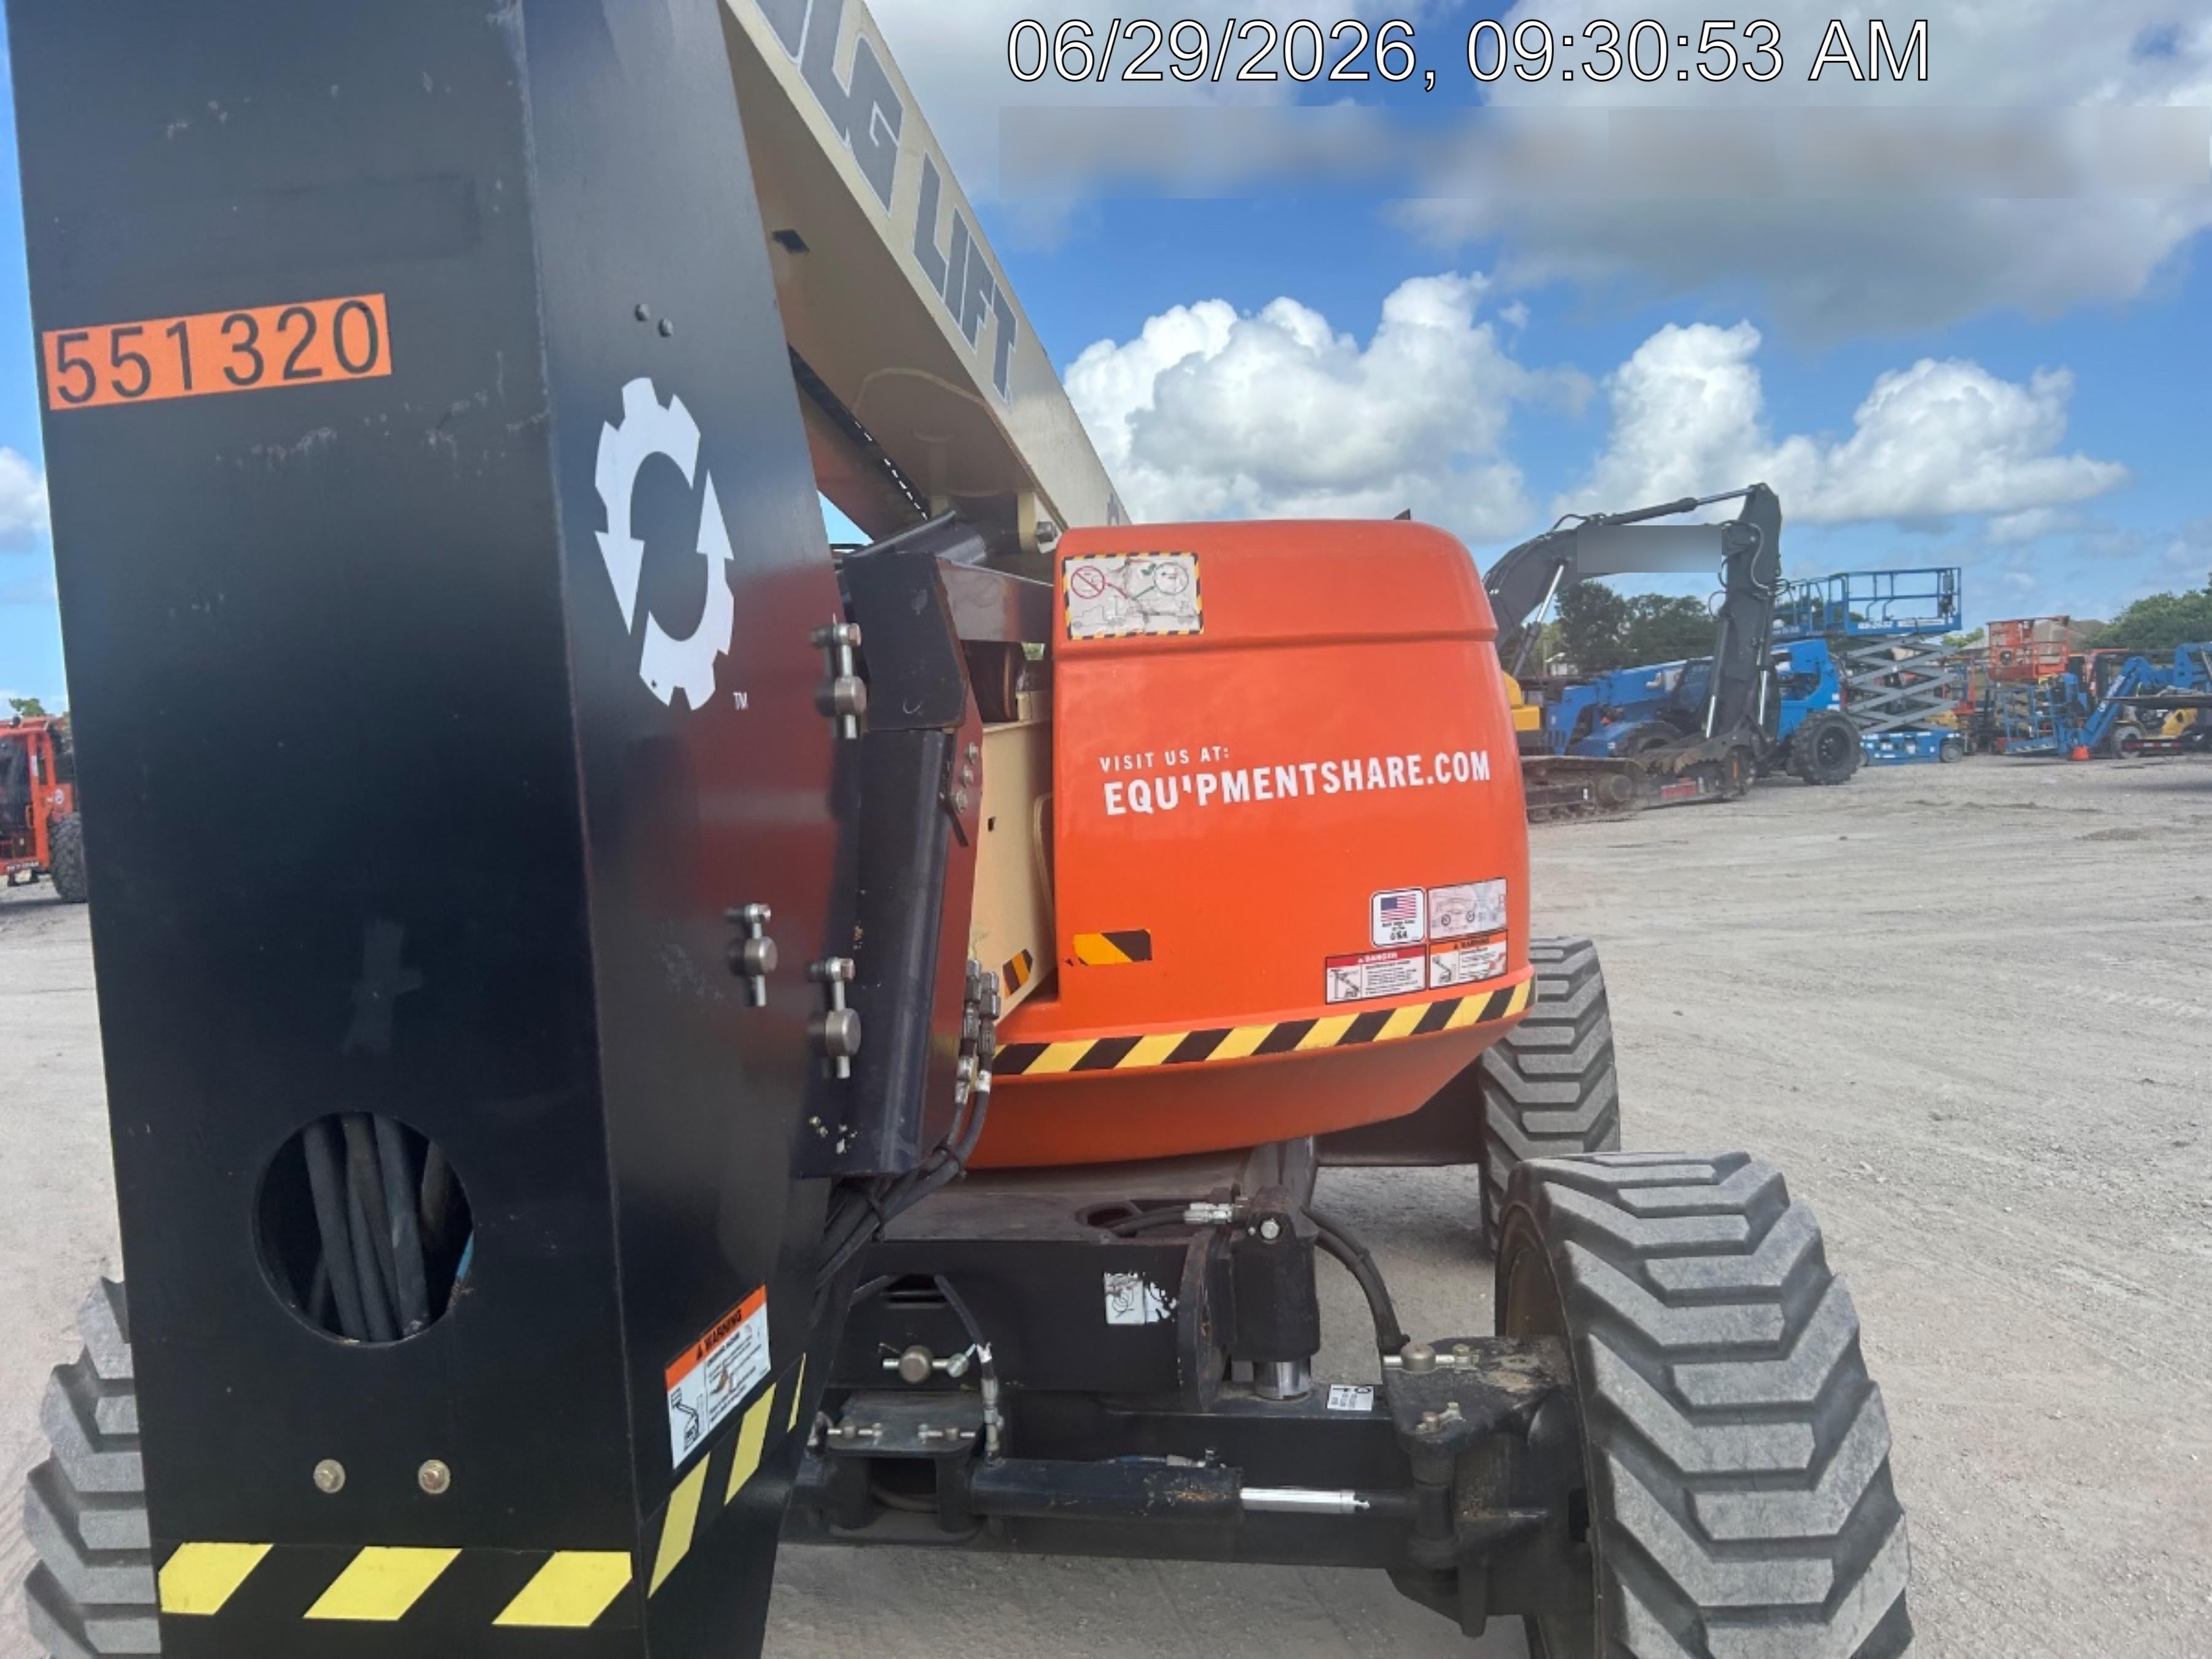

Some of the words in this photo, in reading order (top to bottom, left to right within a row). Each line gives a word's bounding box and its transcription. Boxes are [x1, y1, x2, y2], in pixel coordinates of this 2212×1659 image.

[913, 151, 1018, 408] LIFT
[56, 299, 379, 404] 551320
[1099, 751, 1155, 773] VISIT
[1164, 749, 1190, 766] US
[1199, 745, 1229, 763] AT:
[704, 1308, 742, 1353] WARNING
